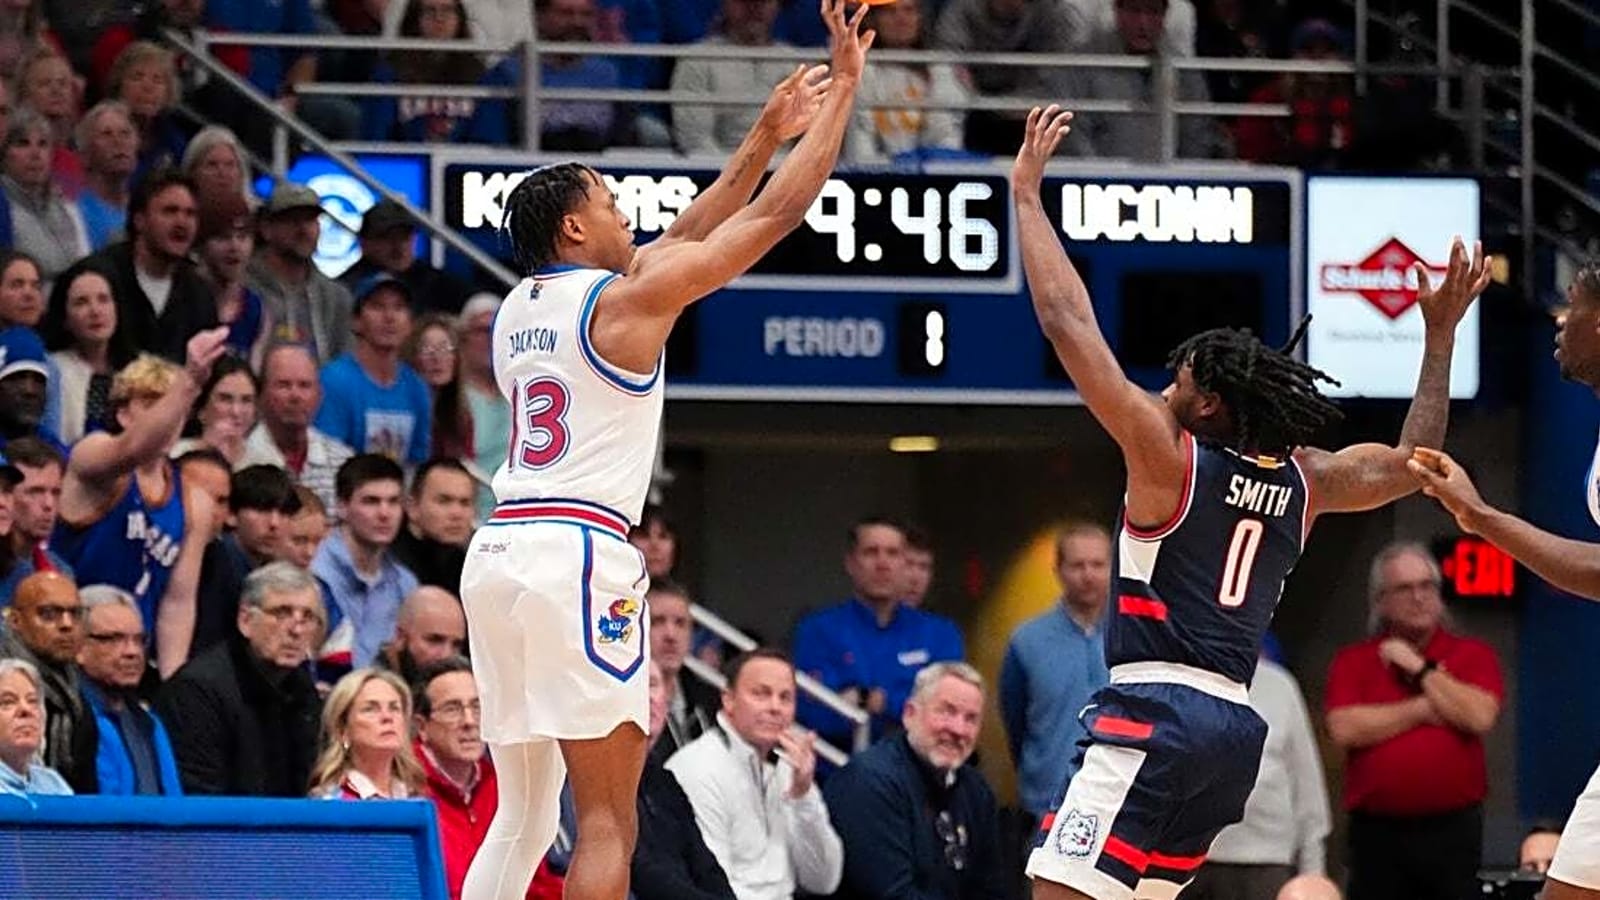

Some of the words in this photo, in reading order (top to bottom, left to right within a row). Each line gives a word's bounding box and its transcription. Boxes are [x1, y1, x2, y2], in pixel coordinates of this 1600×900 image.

[463, 172, 698, 232] KAS
[804, 179, 999, 271] 9:46
[1062, 184, 1253, 243] UCONN
[508, 327, 558, 358] JACKSON
[764, 315, 885, 358] PERIOD
[1225, 474, 1292, 517] SMITH
[1216, 517, 1265, 609] 0
